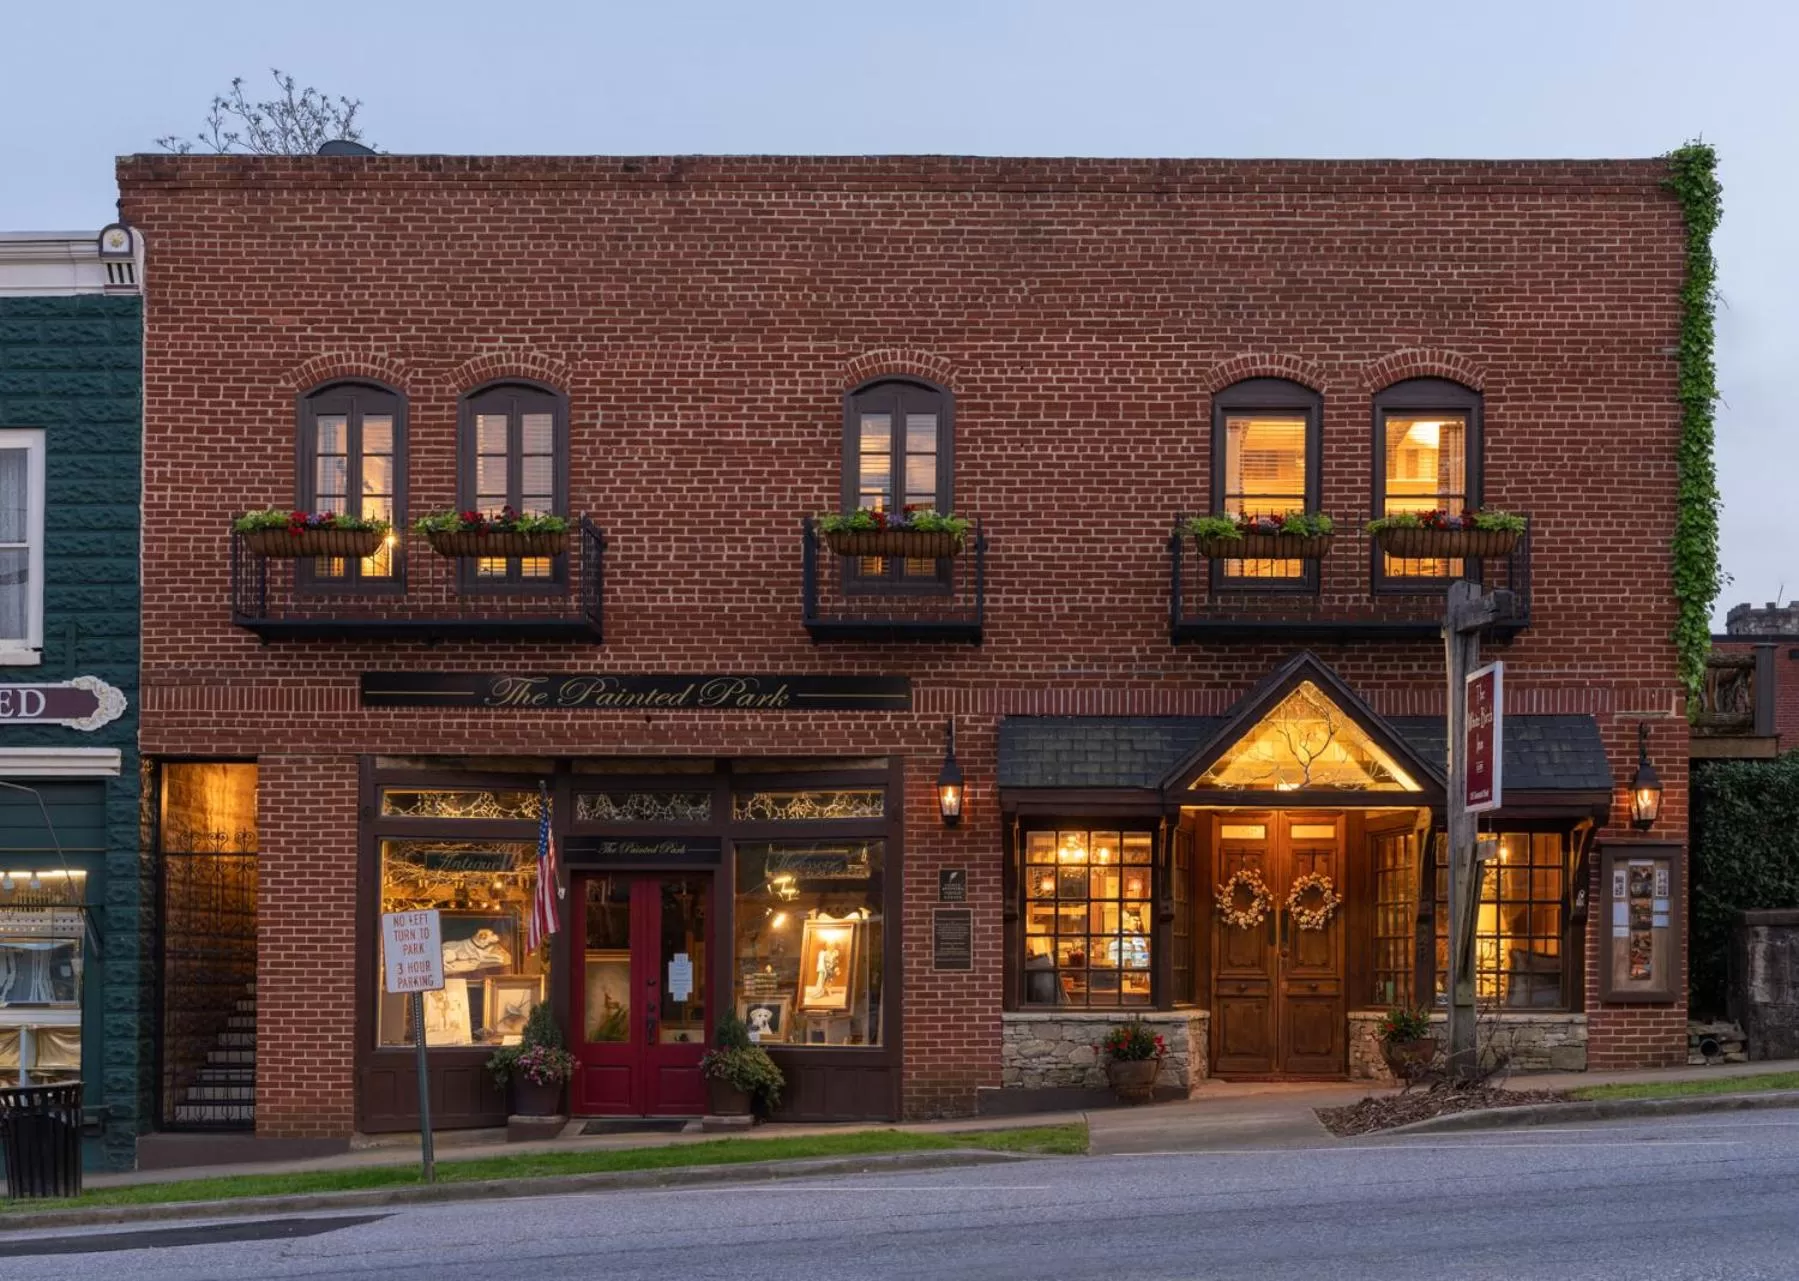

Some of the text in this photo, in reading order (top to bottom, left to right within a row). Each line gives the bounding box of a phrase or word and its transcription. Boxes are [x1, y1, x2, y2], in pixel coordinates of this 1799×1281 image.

[484, 675, 790, 707] The Painted Park
[599, 840, 686, 855] The Painted Park
[393, 913, 428, 927] NO LEFT
[394, 927, 429, 942] TURN TO
[403, 944, 424, 956] PARK
[396, 960, 431, 974] 3 HOUR
[397, 974, 434, 989] PARKING
